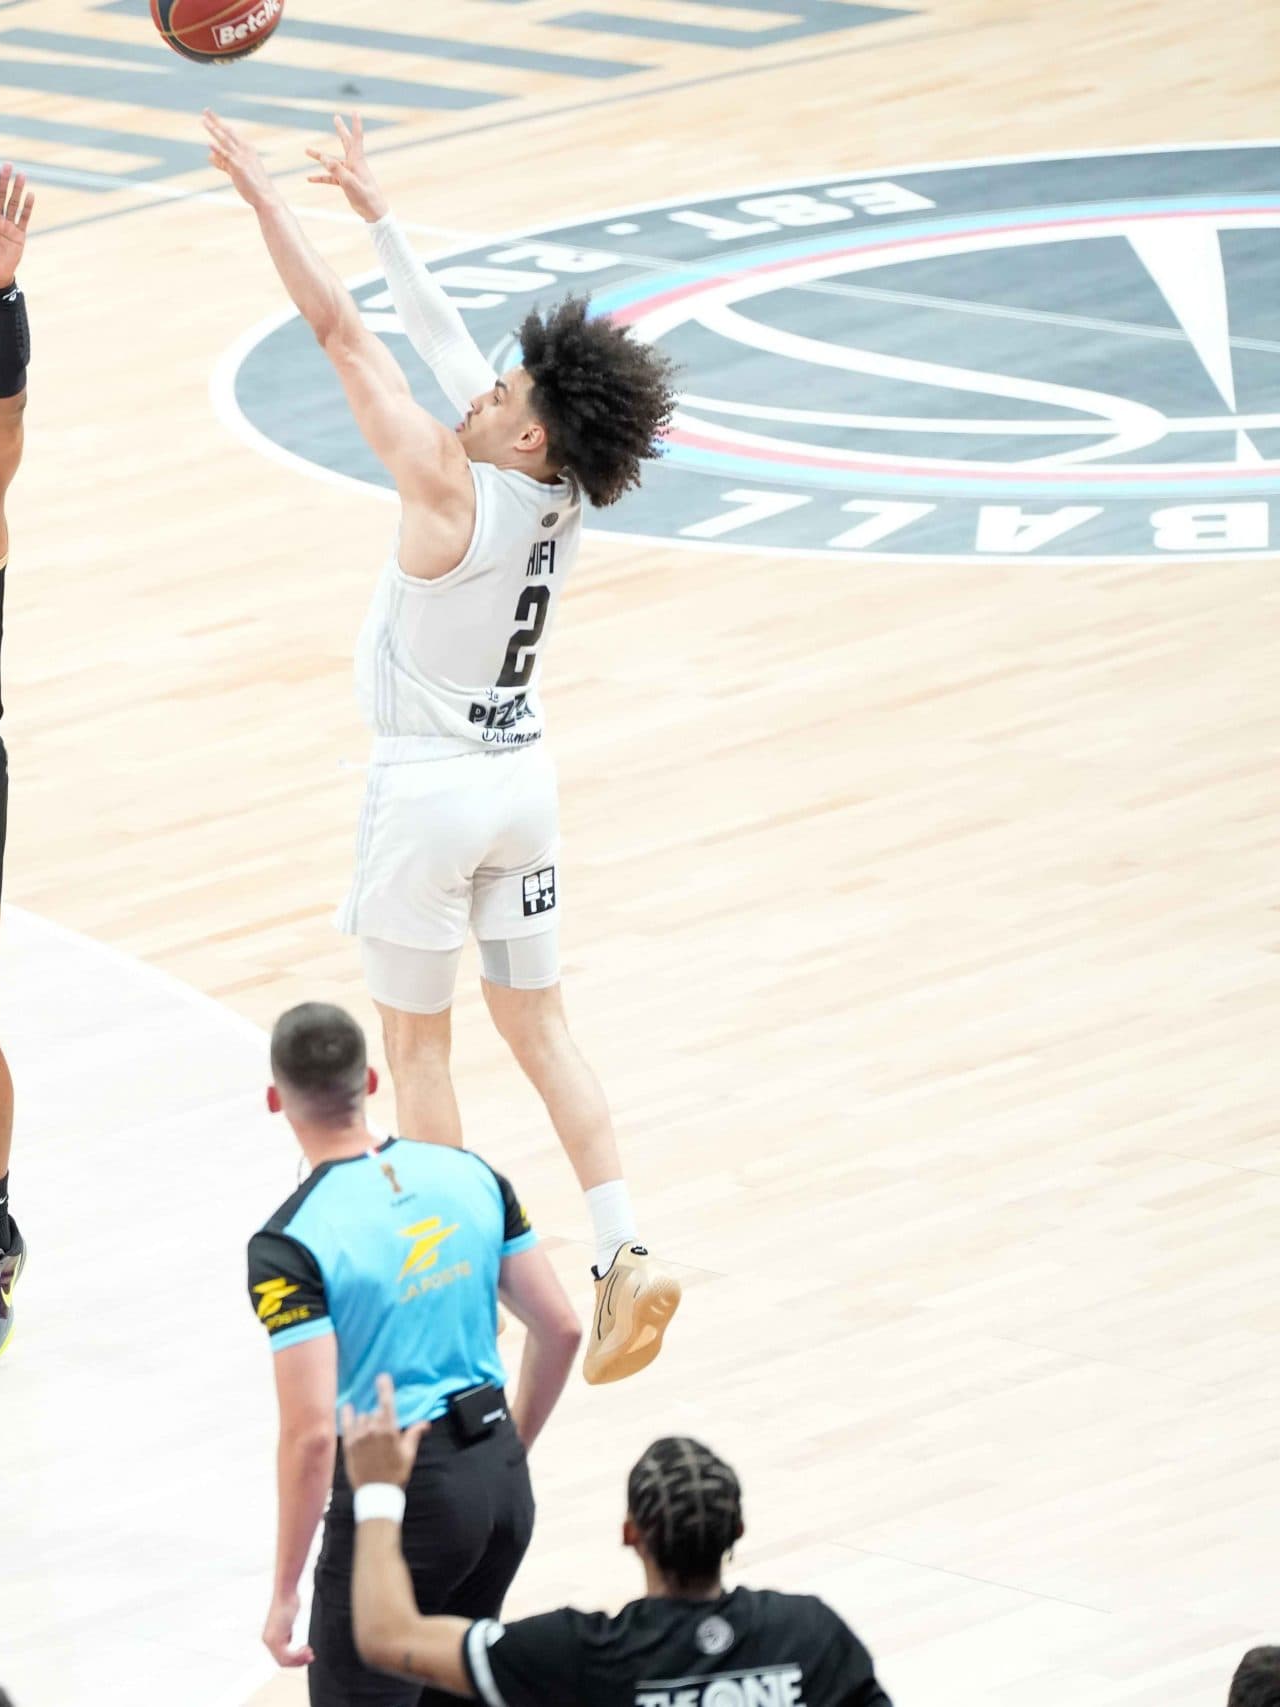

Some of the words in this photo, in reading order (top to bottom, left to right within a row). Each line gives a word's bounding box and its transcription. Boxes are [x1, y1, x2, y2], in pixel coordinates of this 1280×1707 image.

[677, 489, 1269, 553] BALL
[526, 540, 556, 577] HIFI
[495, 585, 550, 687] 2
